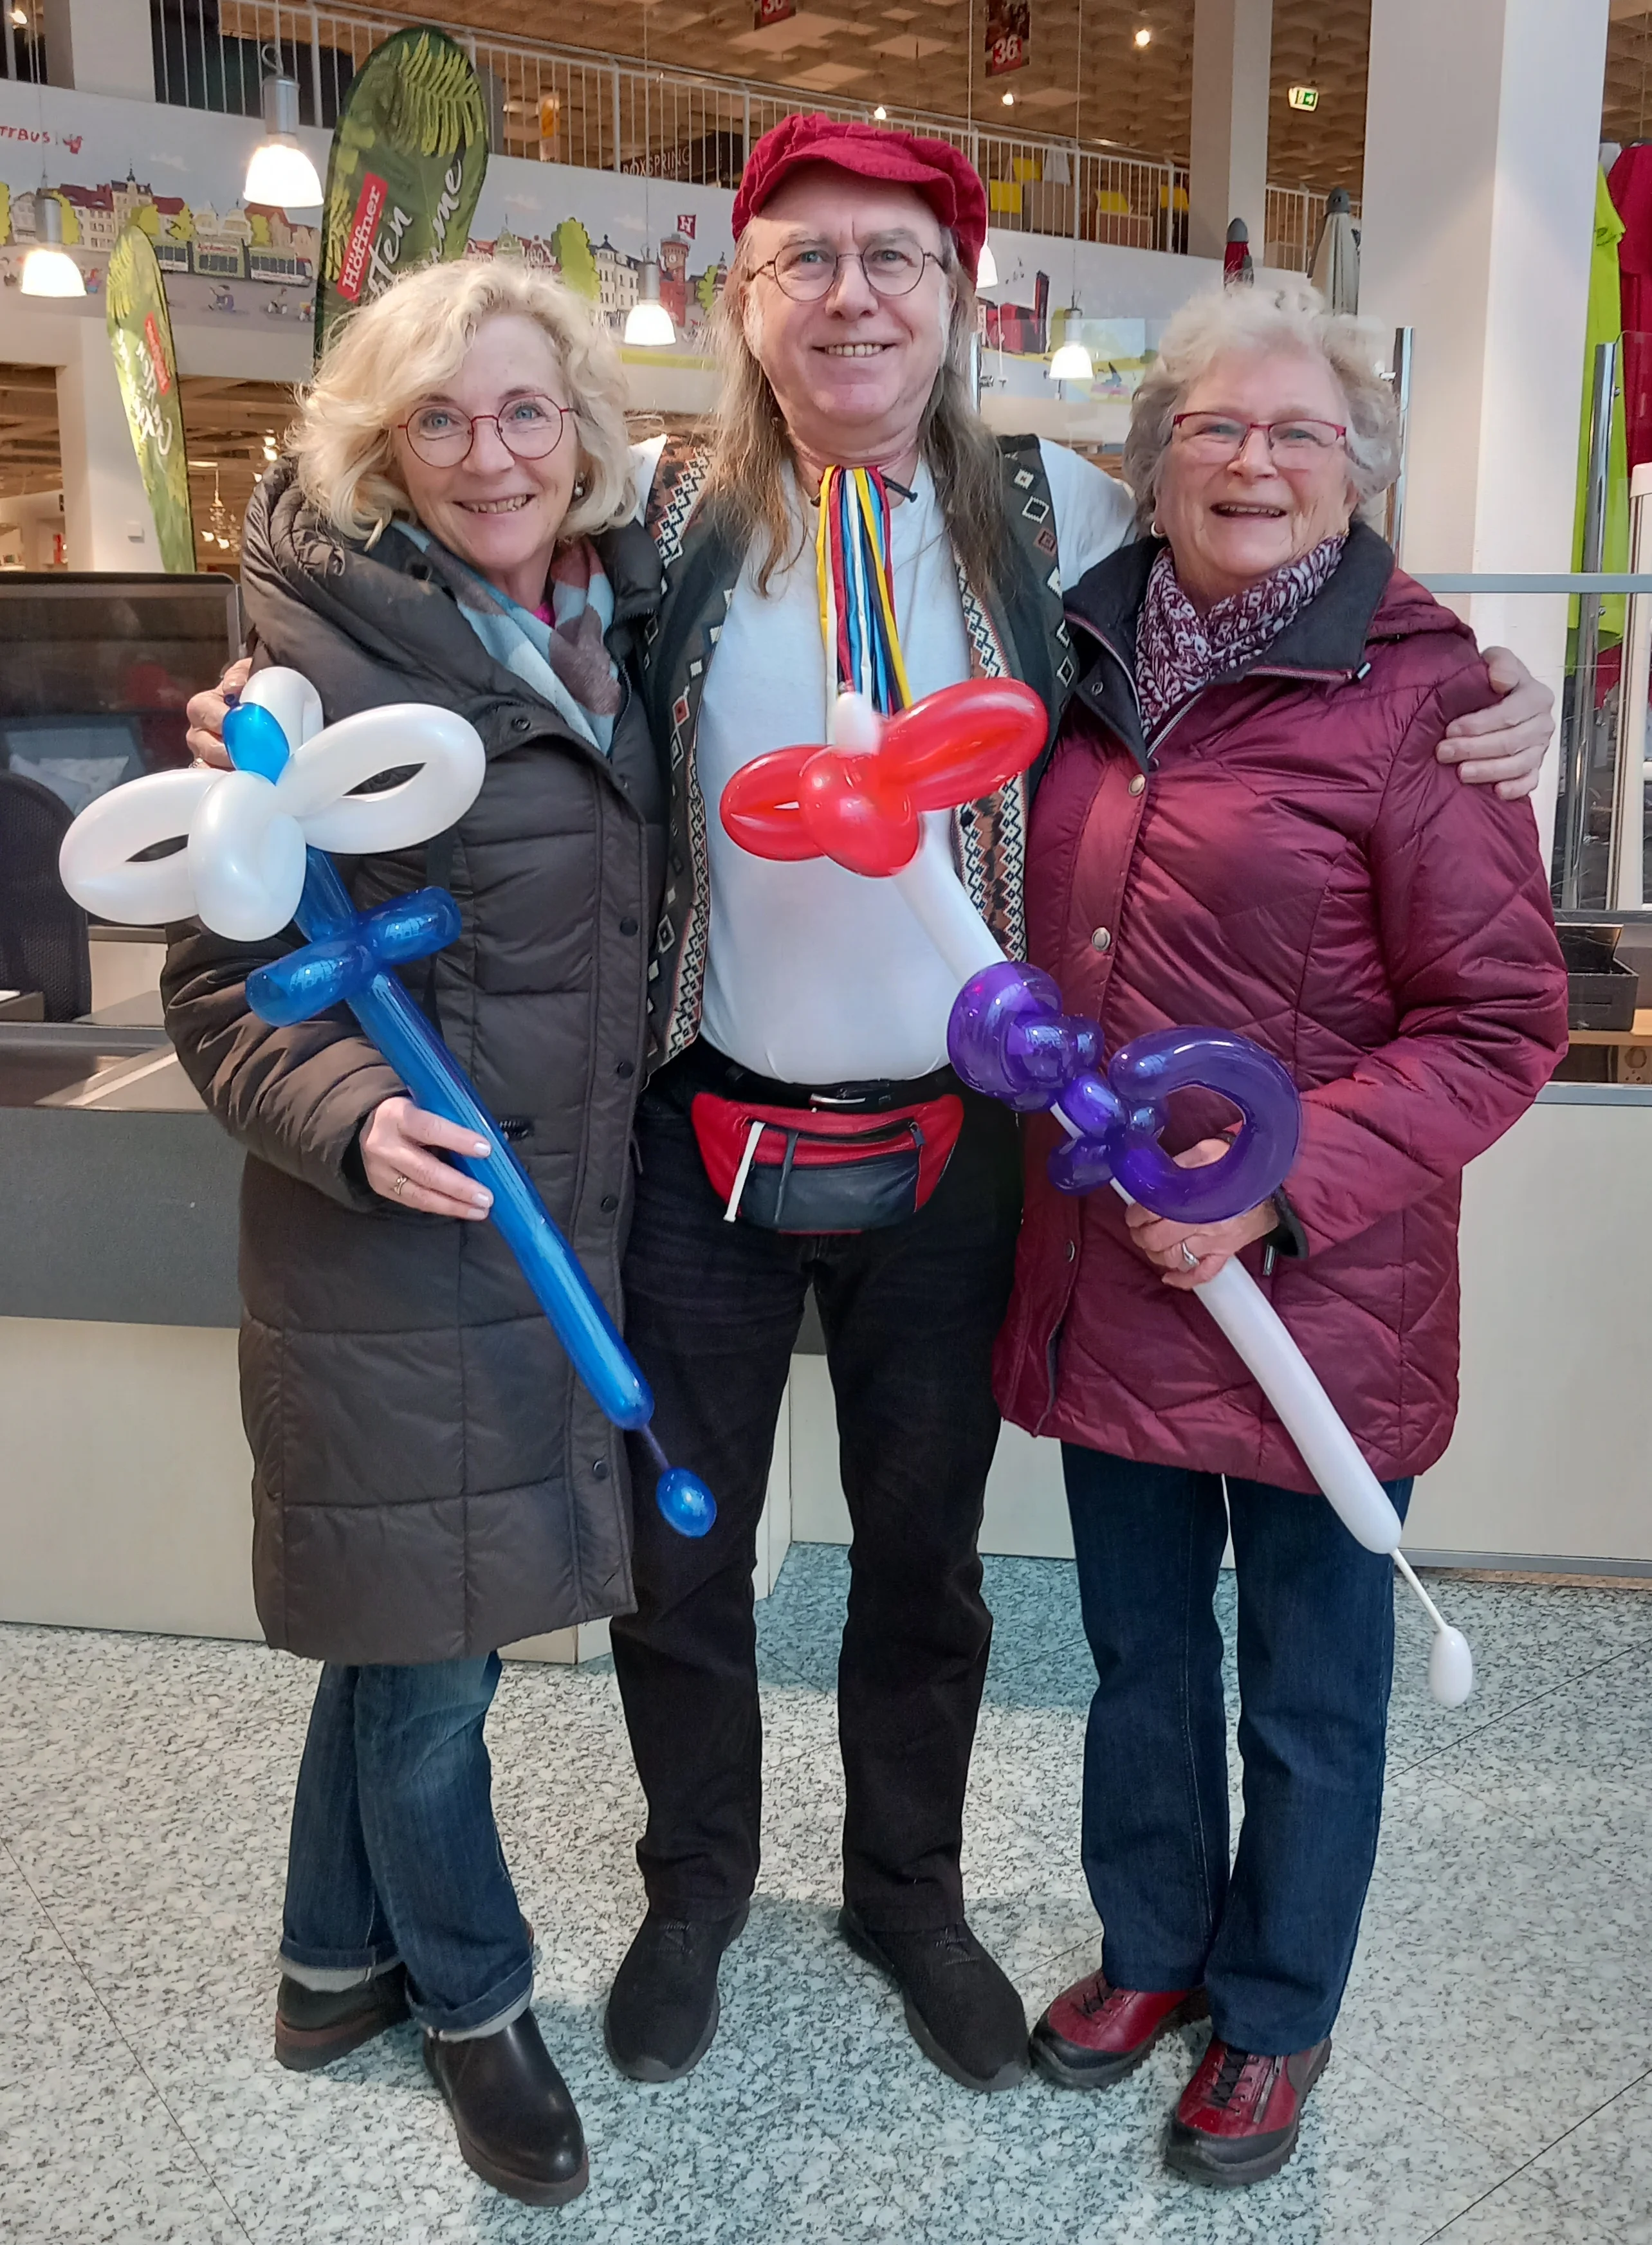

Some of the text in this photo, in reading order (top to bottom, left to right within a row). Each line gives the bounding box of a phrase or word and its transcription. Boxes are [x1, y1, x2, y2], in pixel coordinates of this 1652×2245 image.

[995, 34, 1018, 64] 36
[0, 126, 50, 143] TTBUS
[680, 215, 693, 233] H
[342, 185, 380, 292] Höffner
